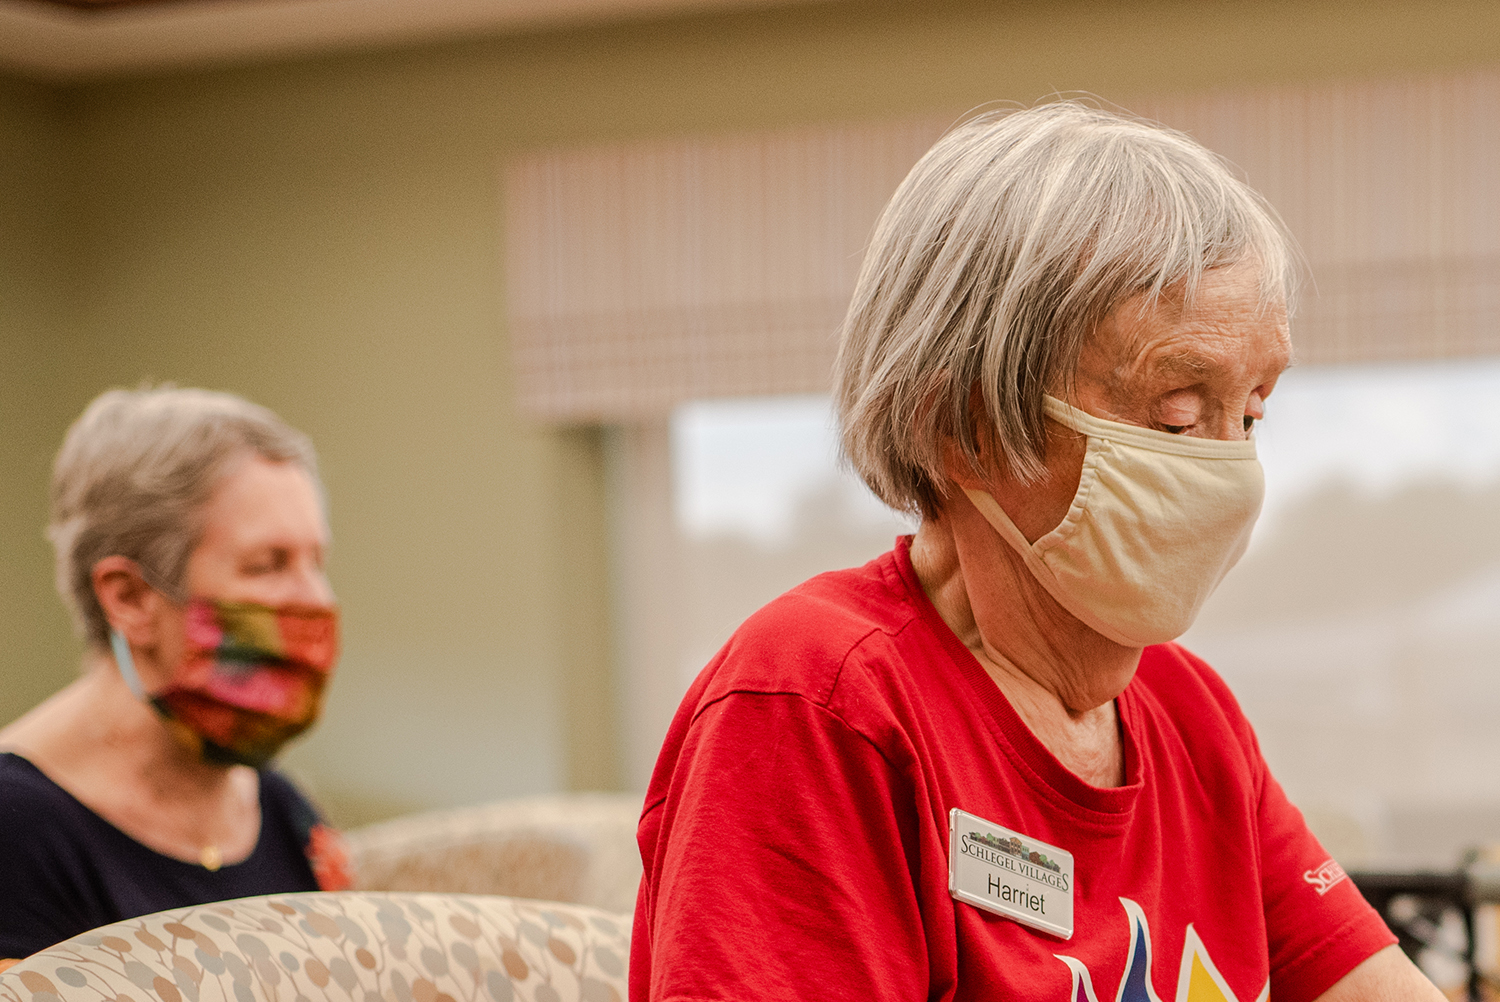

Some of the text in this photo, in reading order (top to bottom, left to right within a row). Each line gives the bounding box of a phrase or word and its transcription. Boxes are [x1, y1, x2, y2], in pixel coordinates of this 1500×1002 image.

[961, 834, 1069, 892] SCHLEGEL VILLAGES
[988, 873, 1045, 915] Harriet
